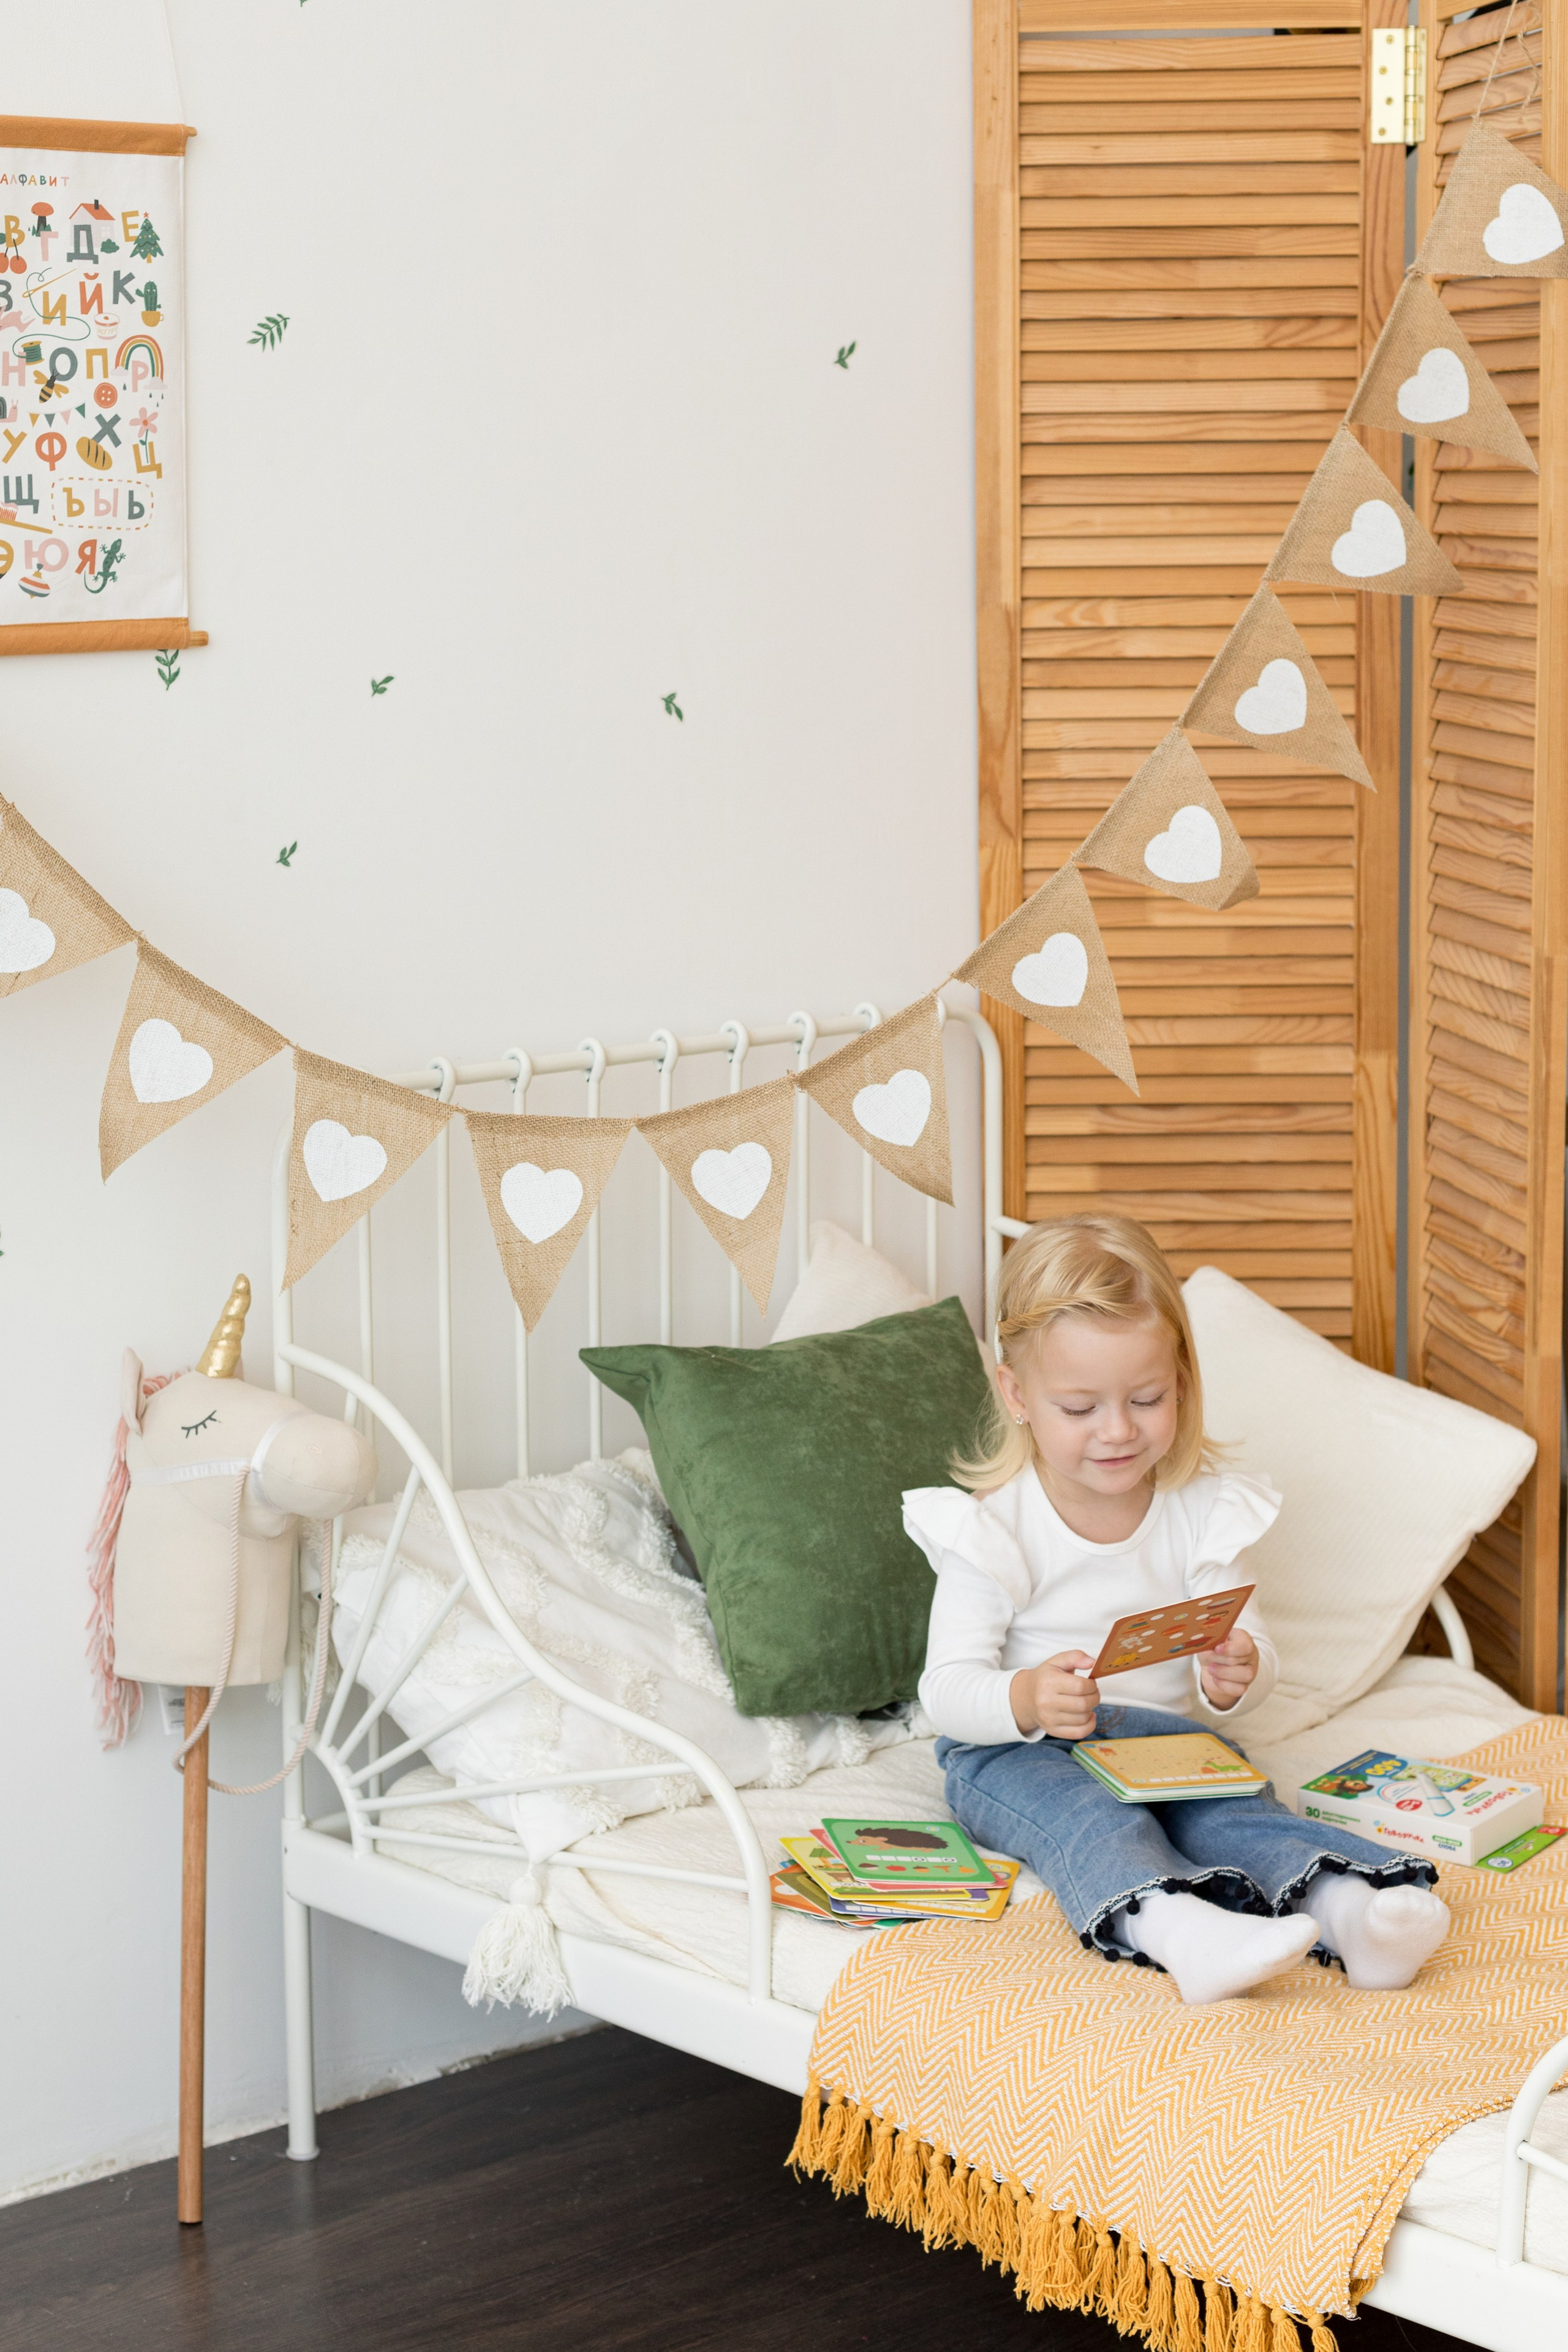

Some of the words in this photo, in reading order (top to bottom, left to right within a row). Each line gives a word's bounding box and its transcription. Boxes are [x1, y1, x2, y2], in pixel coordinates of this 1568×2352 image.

[0, 173, 69, 186] АЛФАВИТ
[5, 215, 26, 247] В
[40, 231, 59, 262] Г
[67, 224, 99, 265] Д
[121, 210, 140, 243] Е
[42, 291, 67, 326] И
[79, 273, 104, 315] Й
[113, 270, 136, 304] К
[1, 351, 26, 386] Н
[49, 347, 78, 382] О
[86, 348, 109, 379] П
[131, 360, 149, 393] Р
[2, 429, 28, 464] У
[35, 432, 67, 471] Ф
[92, 413, 122, 448] Х
[132, 441, 163, 480] Ц
[3, 474, 40, 514] Щ
[62, 488, 85, 518] Ъ
[94, 488, 119, 518] Ы
[128, 490, 145, 520] Ь
[24, 538, 69, 572] Ю
[75, 538, 97, 576] Я
[1306, 1806, 1320, 1819] 30
